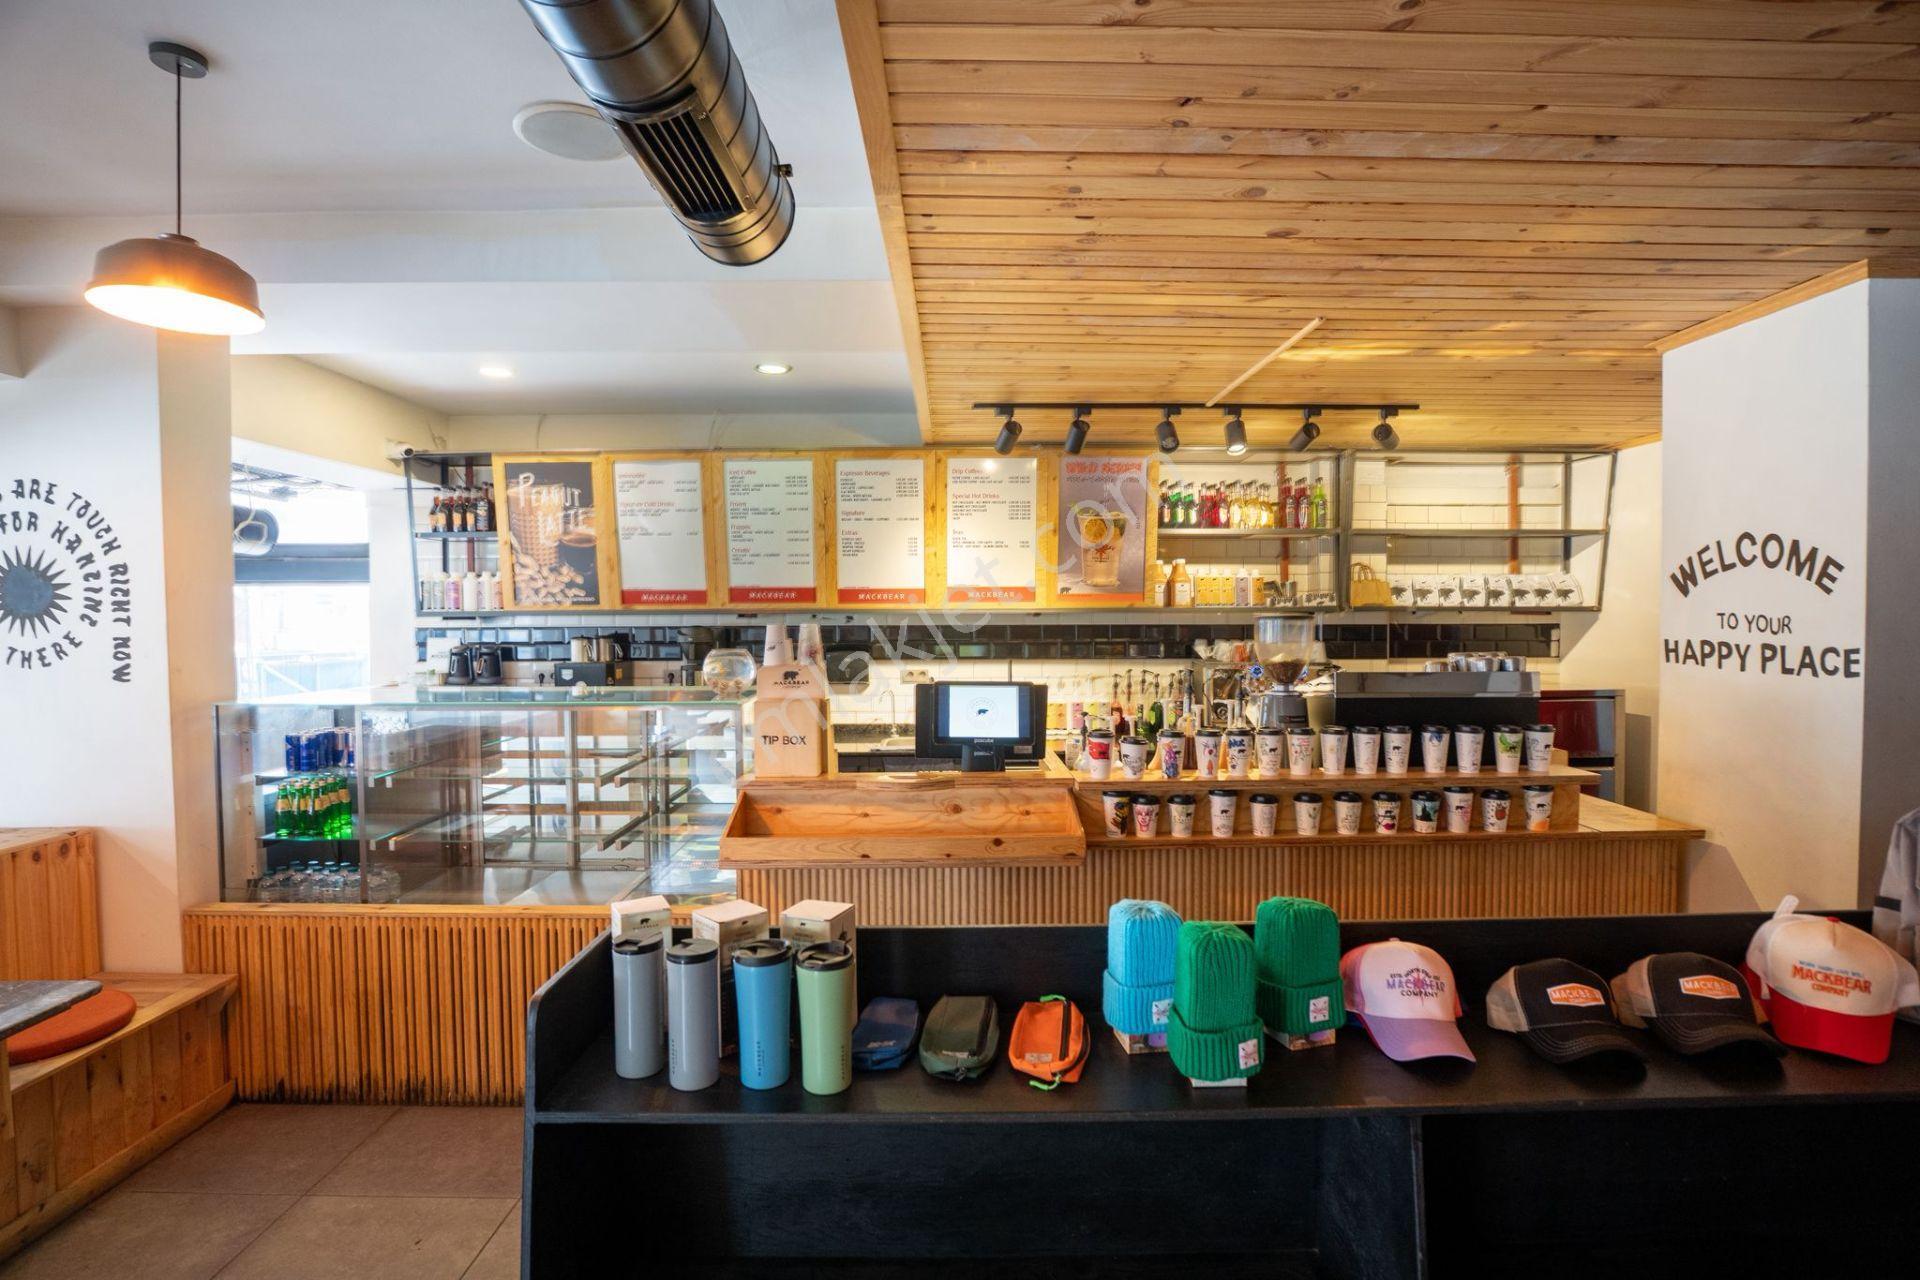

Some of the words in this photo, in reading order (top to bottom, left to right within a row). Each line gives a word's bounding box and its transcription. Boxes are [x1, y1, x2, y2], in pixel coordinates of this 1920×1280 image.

[11, 479, 57, 505] ARE
[0, 511, 38, 535] FOR
[66, 492, 122, 556] TOUGH
[1670, 531, 1845, 598] WELCOME
[108, 562, 131, 627] RIGHT
[749, 591, 796, 599] MACKBEAR
[968, 591, 1016, 599] MACKBEAR
[1717, 613, 1739, 630] TO
[1744, 614, 1792, 635] YOUR
[6, 630, 83, 670] THERE
[112, 636, 131, 683] NOW
[1664, 639, 1751, 672] HAPPY
[1760, 643, 1861, 678] PLACE
[761, 735, 779, 745] TIP
[783, 735, 807, 745] BOX
[1792, 964, 1872, 995] MACKBEAR
[1812, 982, 1849, 997] COMPANY
[1400, 990, 1439, 998] COMPANY
